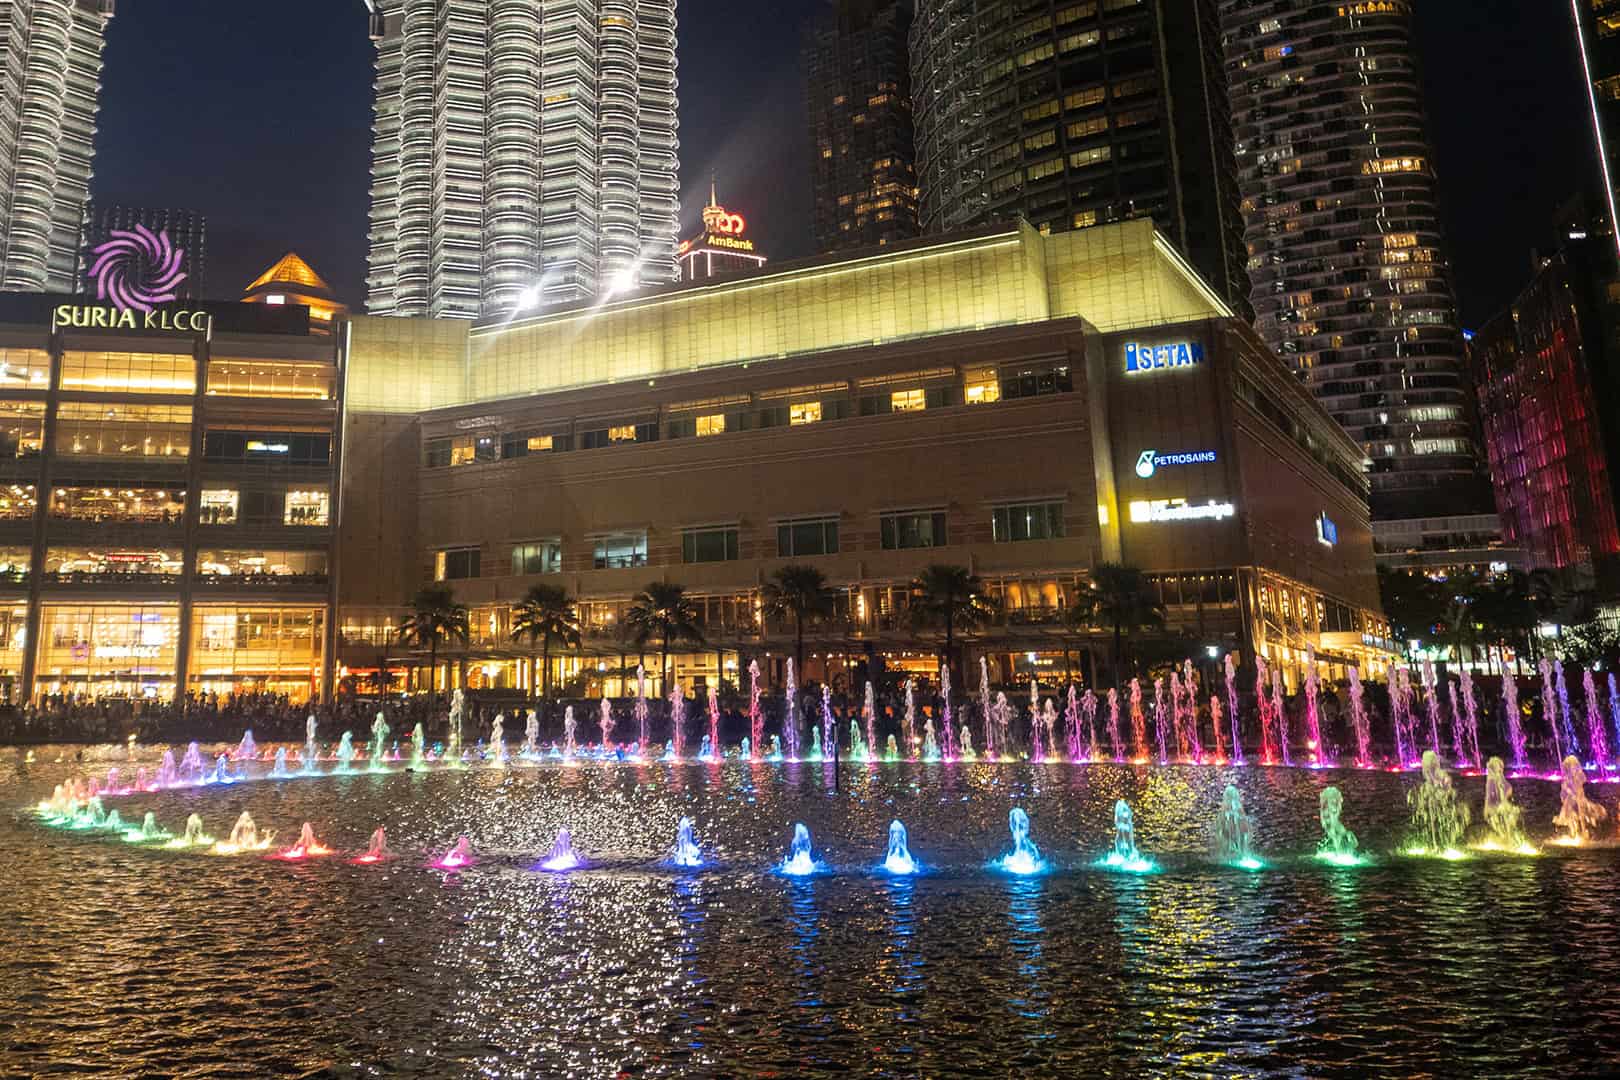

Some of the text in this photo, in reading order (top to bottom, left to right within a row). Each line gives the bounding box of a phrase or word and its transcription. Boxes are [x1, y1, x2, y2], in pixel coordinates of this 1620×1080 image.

[708, 235, 753, 250] AmBank
[56, 305, 207, 331] SURIA KLCC
[1154, 452, 1215, 466] PETROSAINS
